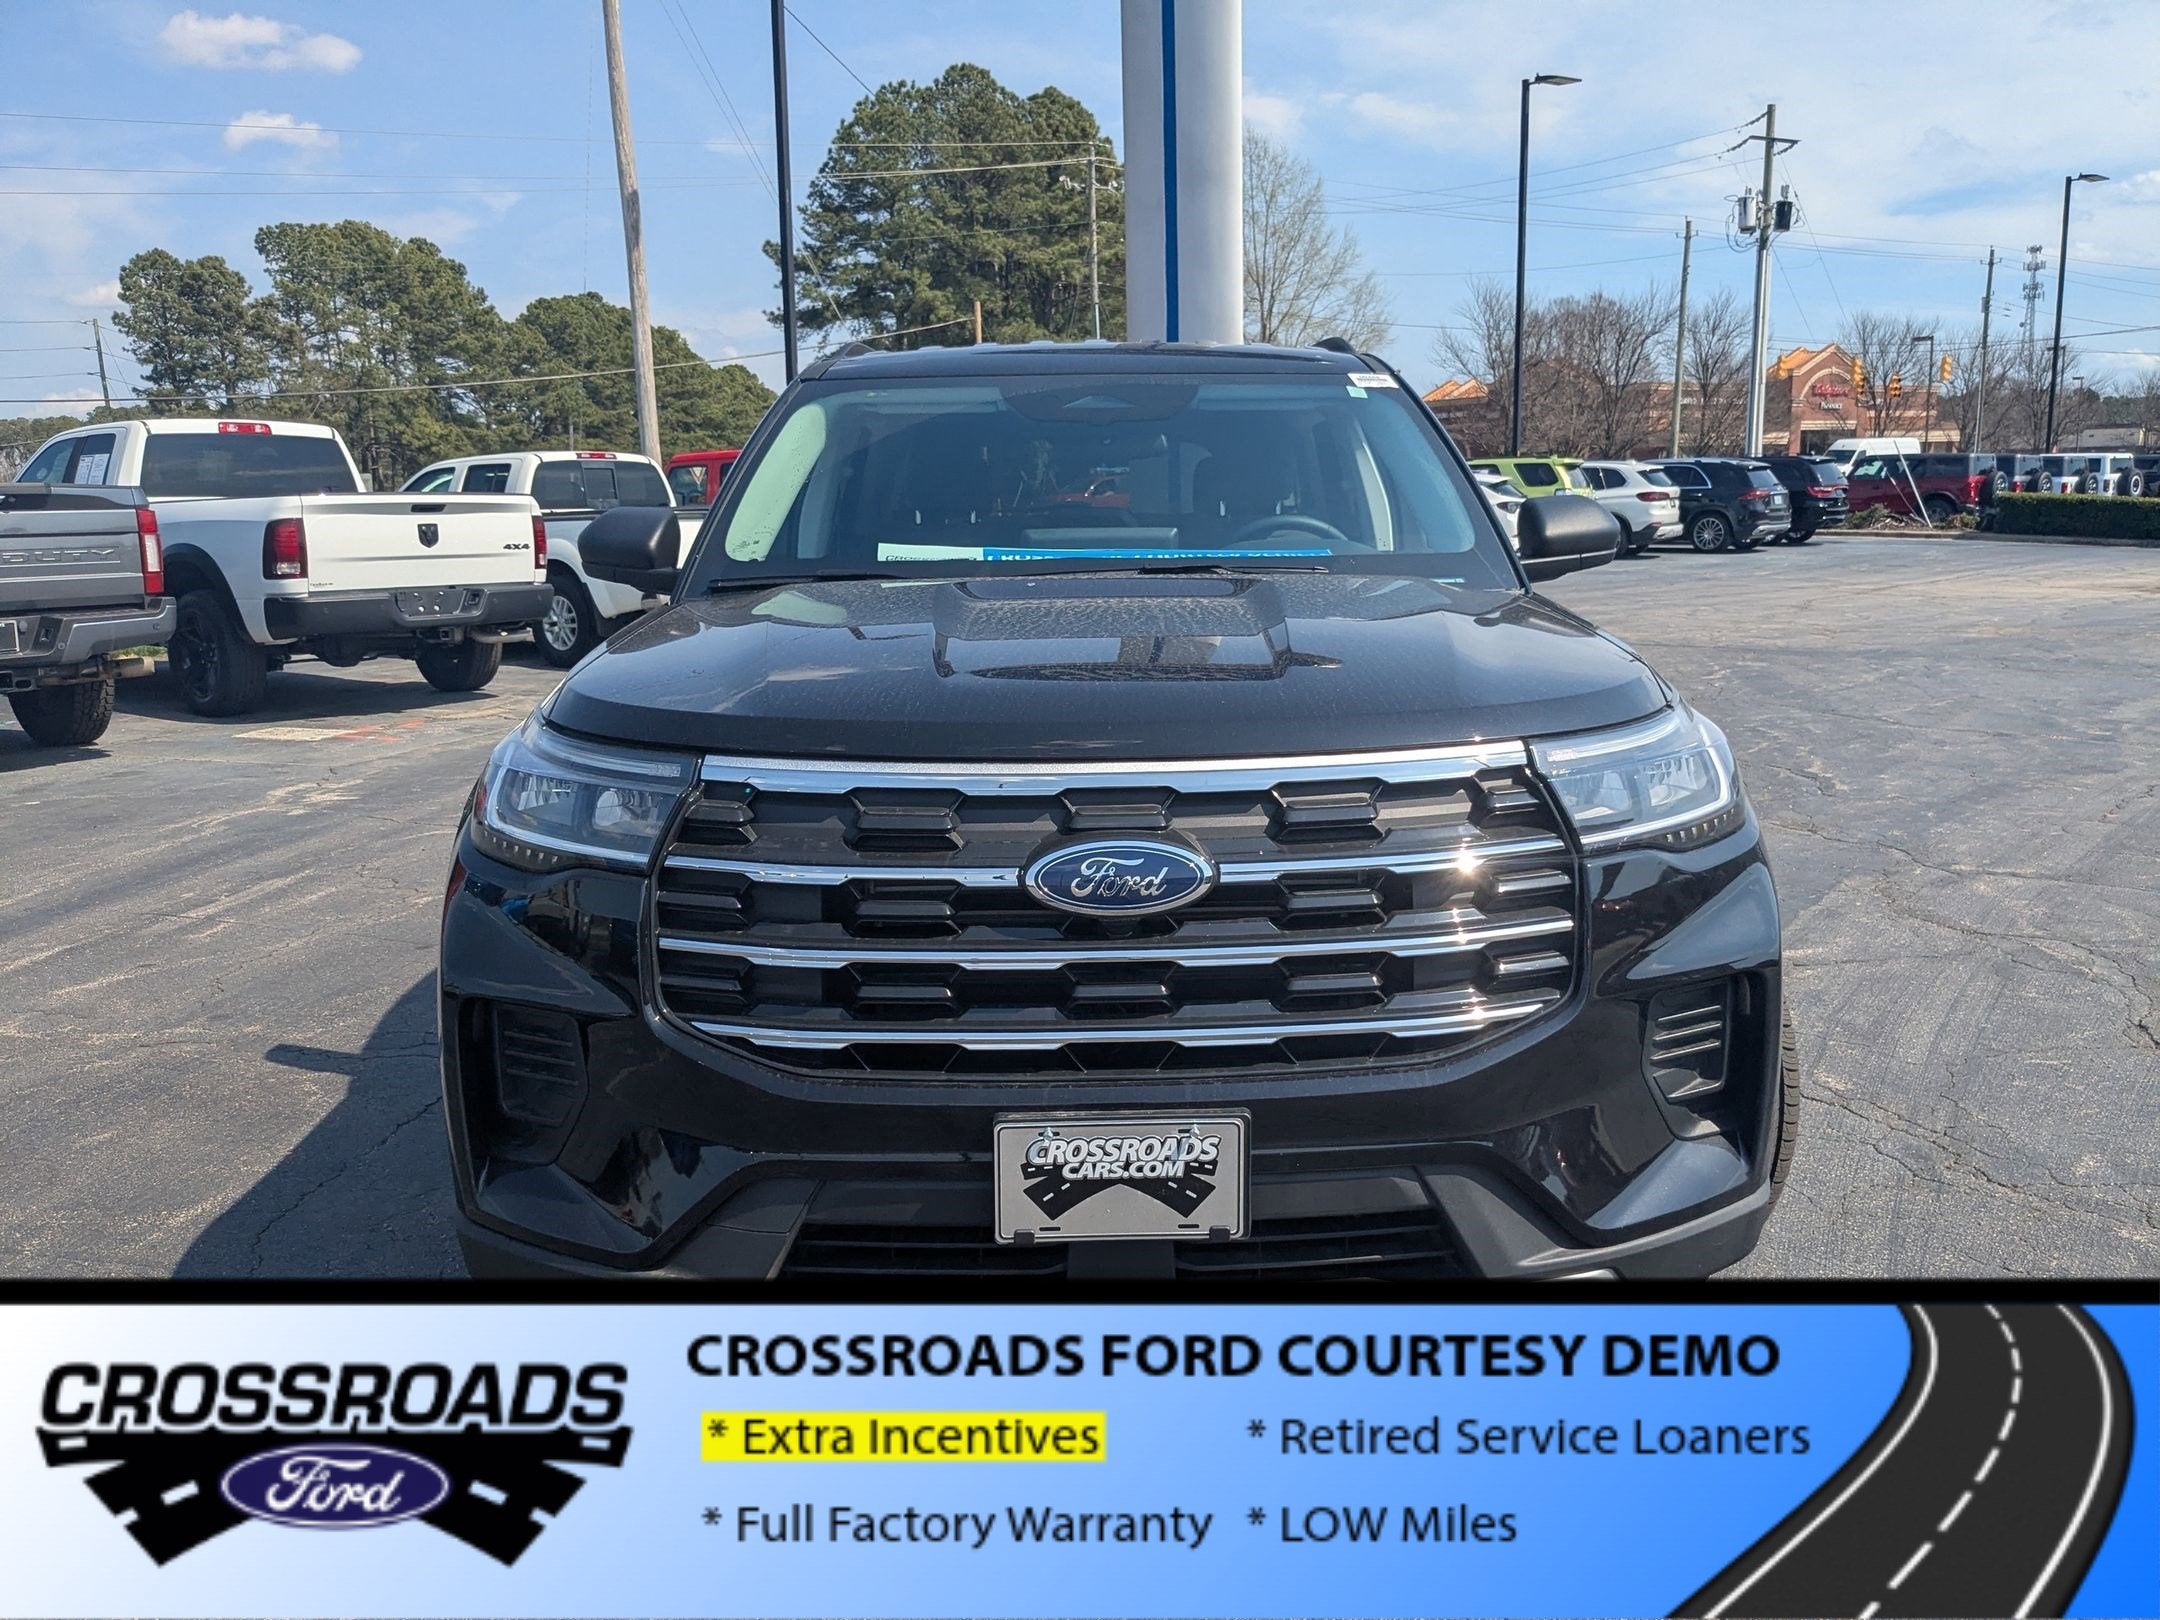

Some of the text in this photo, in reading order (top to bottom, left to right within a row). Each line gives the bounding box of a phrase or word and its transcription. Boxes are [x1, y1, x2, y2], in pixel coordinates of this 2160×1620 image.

[2, 549, 117, 563] DUTY
[1070, 857, 1168, 897] Ford
[1026, 1135, 1222, 1165] CROSSROADS
[1062, 1160, 1186, 1180] CARS.COM
